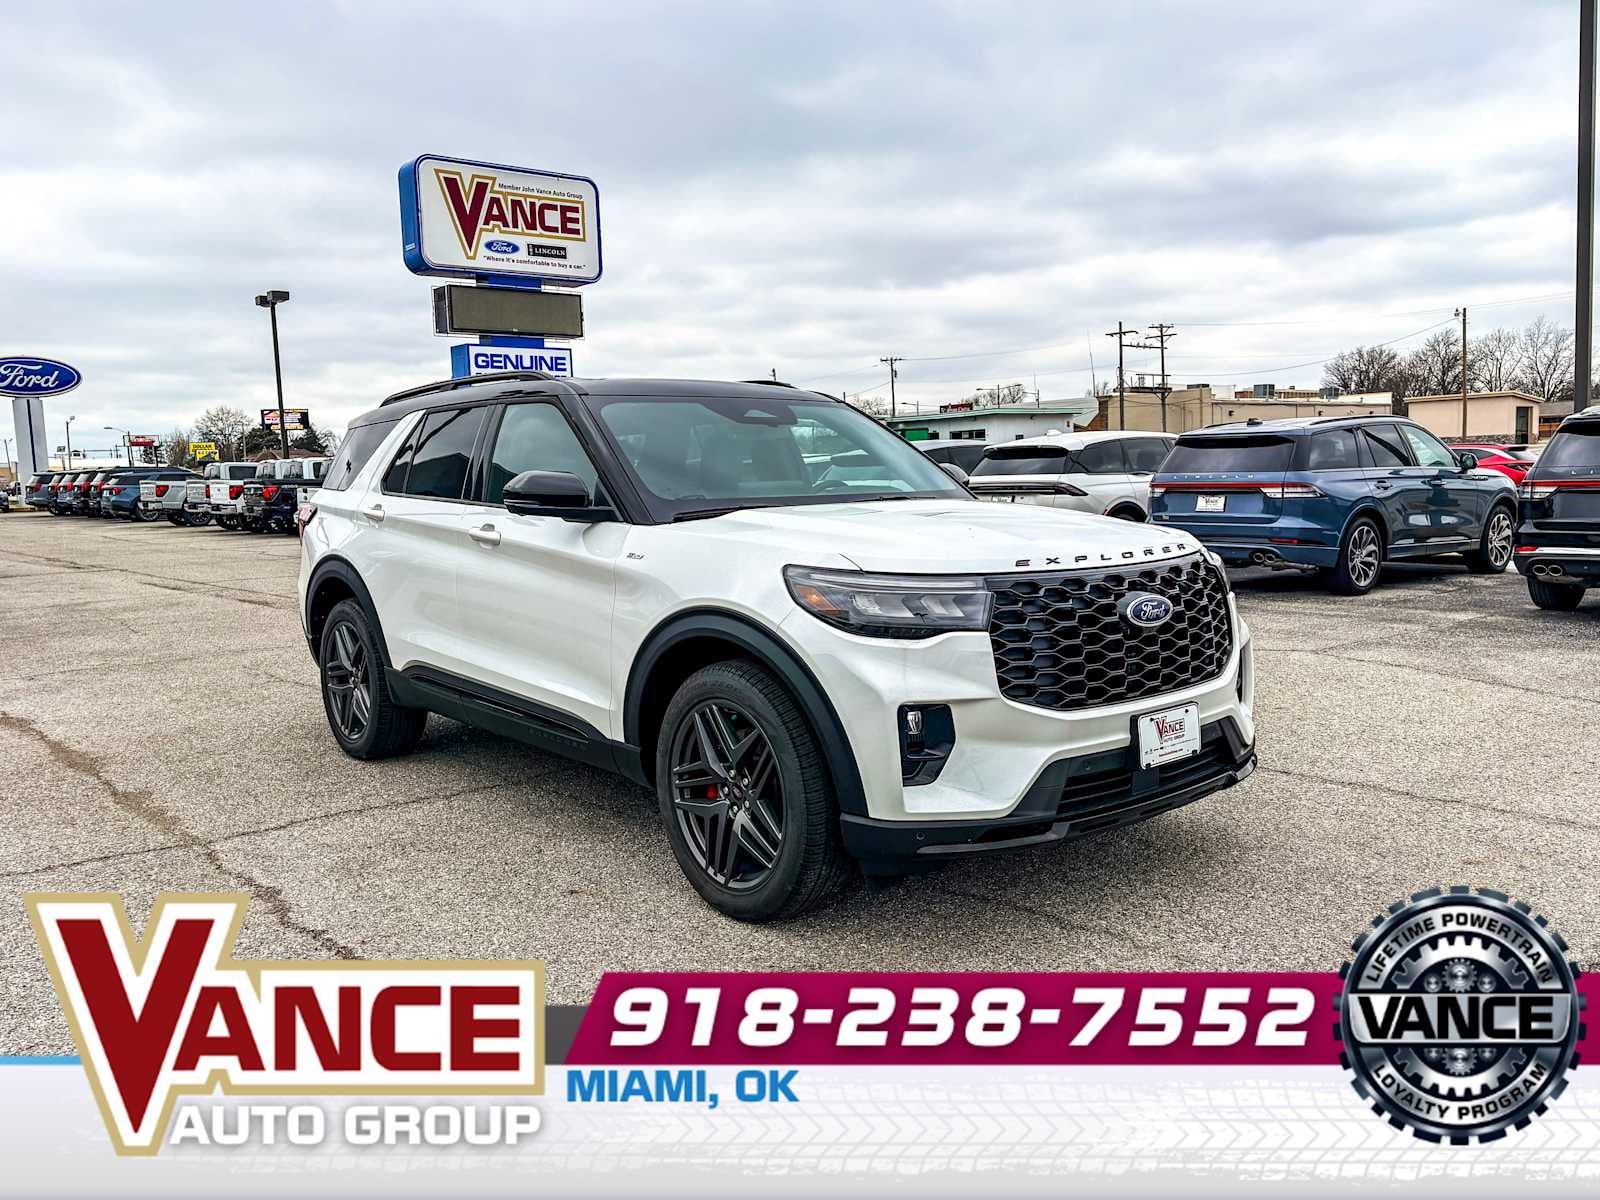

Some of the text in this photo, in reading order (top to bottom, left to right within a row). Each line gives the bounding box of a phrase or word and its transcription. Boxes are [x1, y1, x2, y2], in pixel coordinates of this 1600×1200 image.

[498, 183, 520, 191] Member
[566, 192, 583, 200] Group
[441, 175, 582, 254] VANCE
[490, 242, 512, 253] Ford
[534, 247, 566, 256] LINCOLN
[515, 259, 550, 267] comfortable
[474, 353, 567, 371] GENUINE
[0, 363, 59, 387] Ford
[1015, 543, 1187, 567] EXPLORER
[1140, 601, 1166, 620] Ford
[1155, 719, 1184, 742] VANCE
